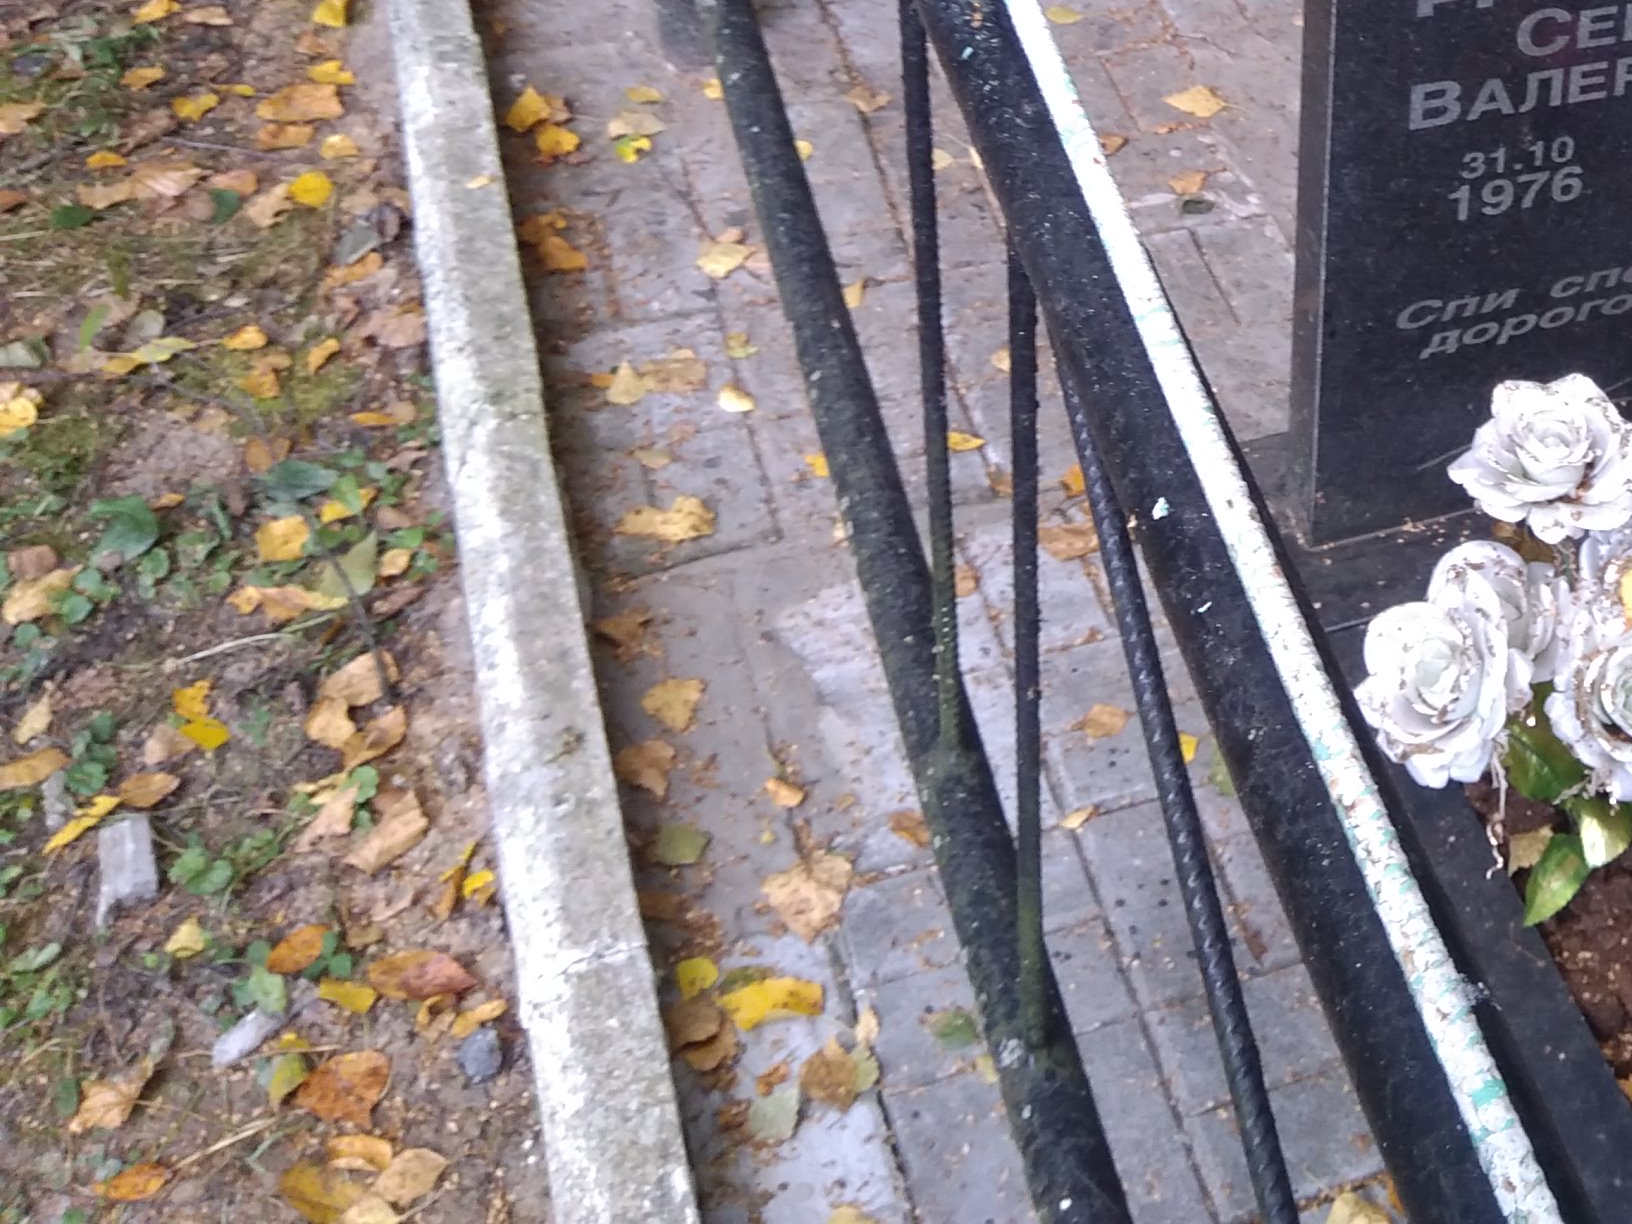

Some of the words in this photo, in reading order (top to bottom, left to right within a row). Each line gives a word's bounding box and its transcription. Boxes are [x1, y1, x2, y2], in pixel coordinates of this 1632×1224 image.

[1461, 136, 1576, 179] 31.10
[1448, 166, 1584, 221] 1976
[1396, 287, 1521, 330] Спи
